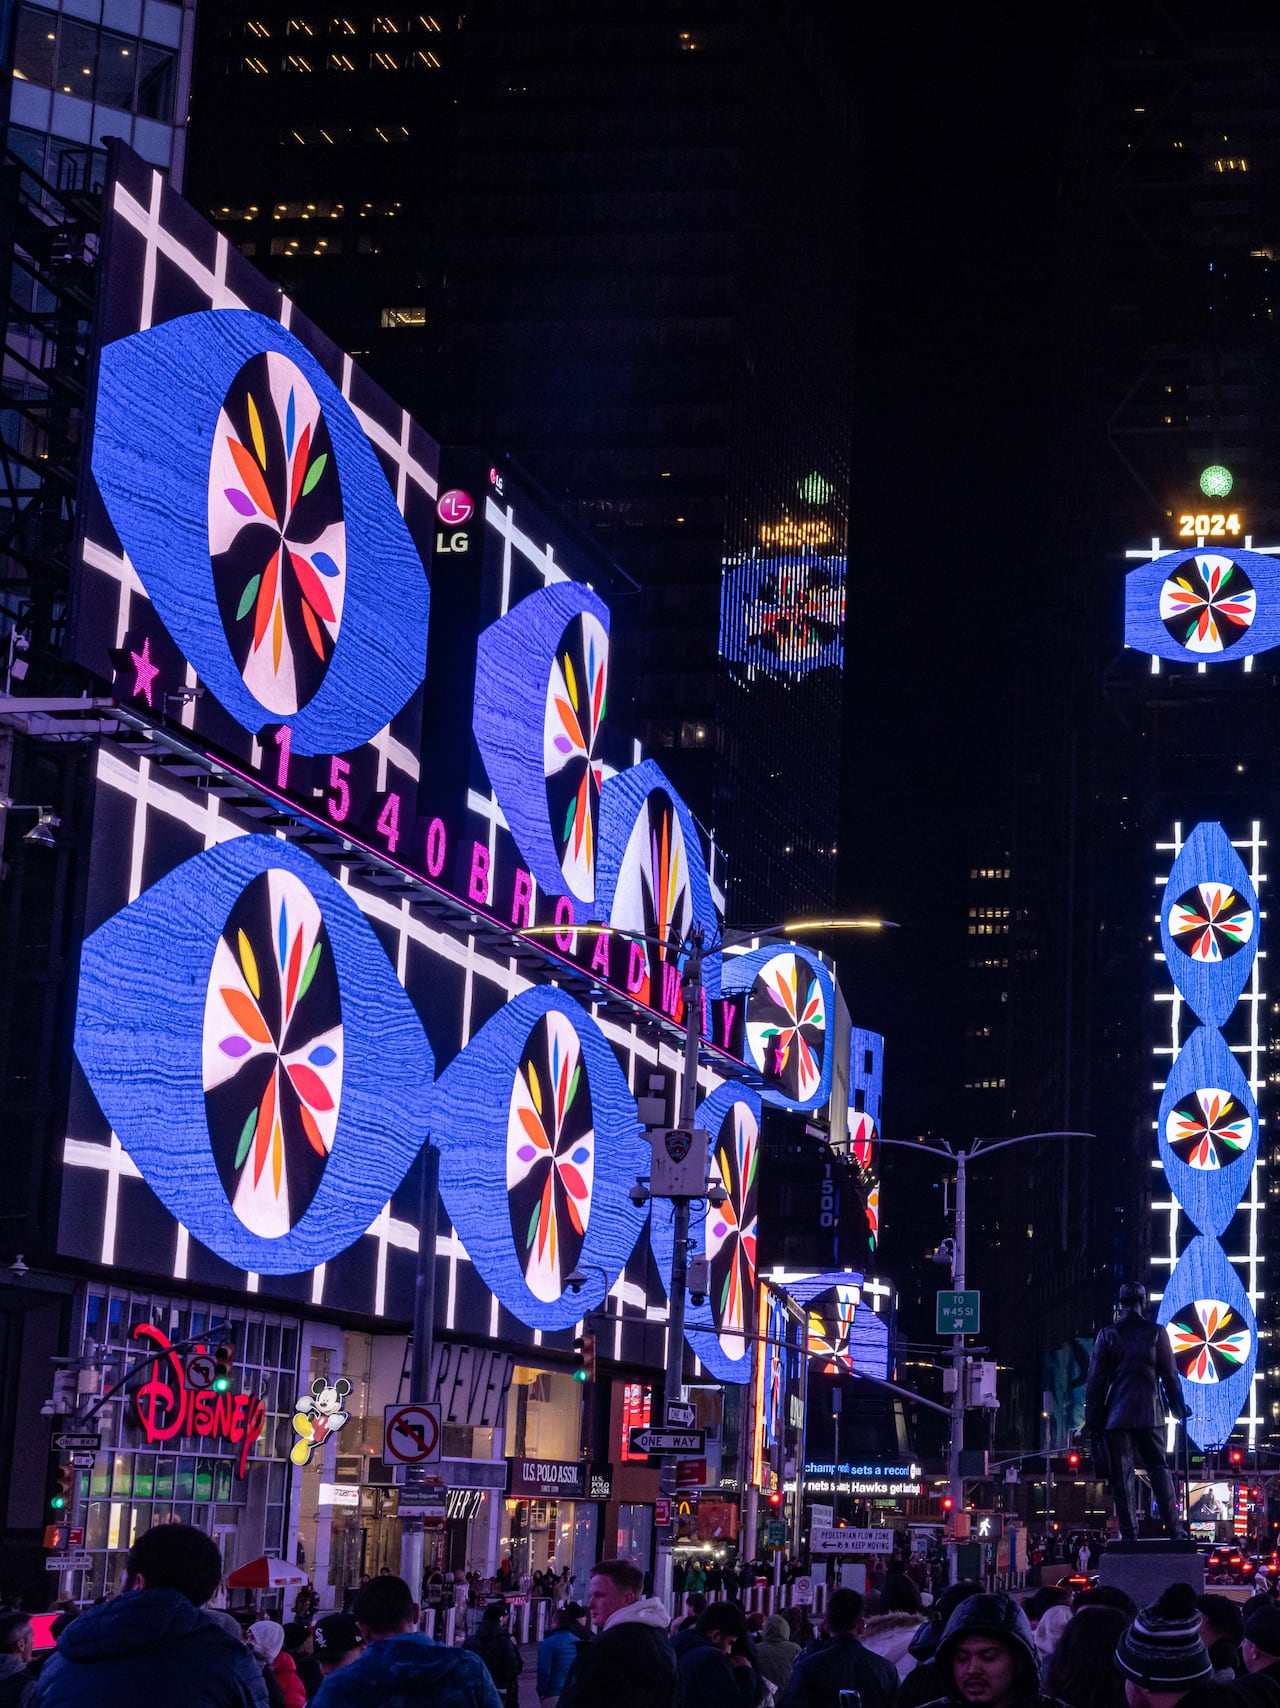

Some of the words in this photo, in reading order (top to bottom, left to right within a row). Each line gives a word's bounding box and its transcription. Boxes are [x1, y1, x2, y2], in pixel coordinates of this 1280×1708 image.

[1179, 514, 1241, 536] 2024
[436, 532, 469, 553] LG
[275, 725, 447, 877] 1540
[953, 1296, 964, 1304] TO
[943, 1307, 950, 1316] W
[951, 1307, 964, 1316] 45
[396, 1336, 515, 1427] FREVER
[59, 1438, 73, 1446] ONE
[80, 1438, 95, 1446] WAY
[641, 1436, 662, 1447] ONE
[673, 1437, 696, 1447] WAY
[523, 1463, 536, 1481] U.S.
[536, 1464, 557, 1482] POLO
[557, 1466, 578, 1484] ASSN.
[851, 1465, 873, 1475] sets
[875, 1467, 881, 1475] a
[884, 1466, 910, 1475] record
[808, 1480, 829, 1491] nets
[851, 1481, 888, 1493] Hawks
[821, 1531, 855, 1539] PEDESTRIAN
[857, 1532, 873, 1540] FLOW
[874, 1532, 889, 1540] ZONE
[851, 1541, 866, 1549] KEEP
[867, 1542, 889, 1550] MOVING
